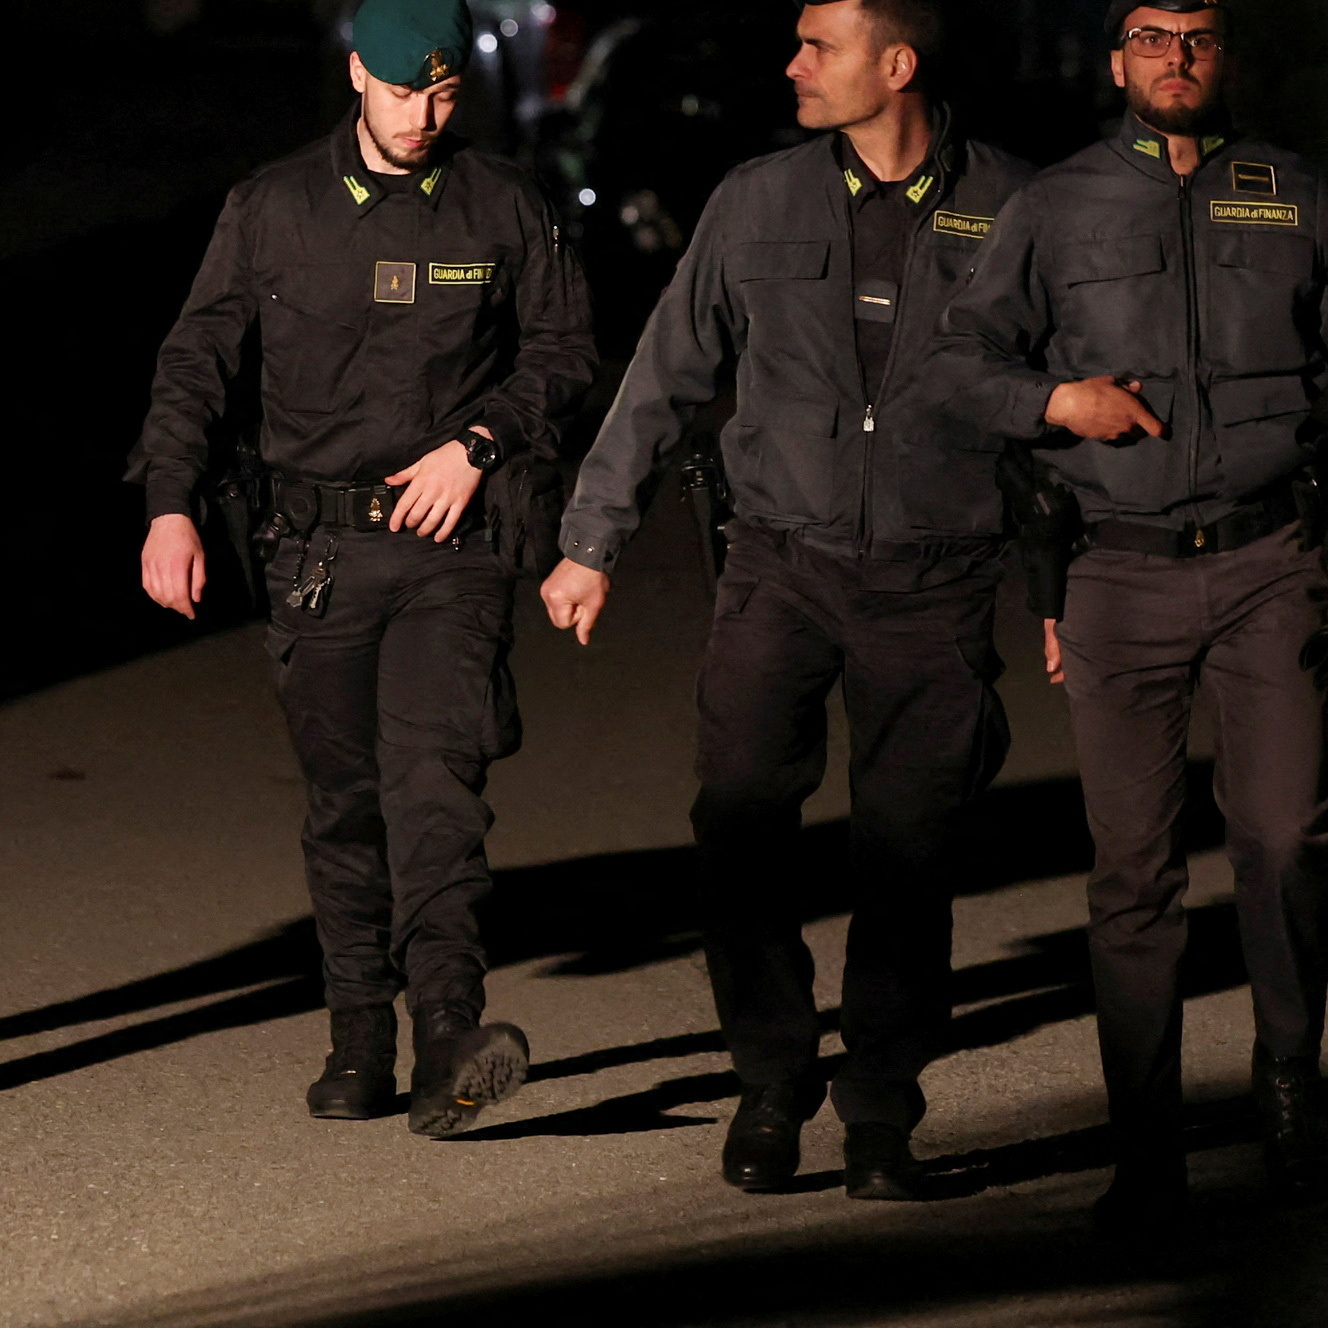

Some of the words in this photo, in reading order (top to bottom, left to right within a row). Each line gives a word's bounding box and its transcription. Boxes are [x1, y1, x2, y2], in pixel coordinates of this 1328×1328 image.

[1214, 206, 1250, 219] GUARDIA
[1250, 209, 1259, 219] di
[1259, 208, 1294, 221] FINANZA
[938, 215, 970, 232] GUARDIA
[970, 223, 978, 233] di
[433, 268, 465, 281] GUARDIA
[466, 269, 472, 280] di
